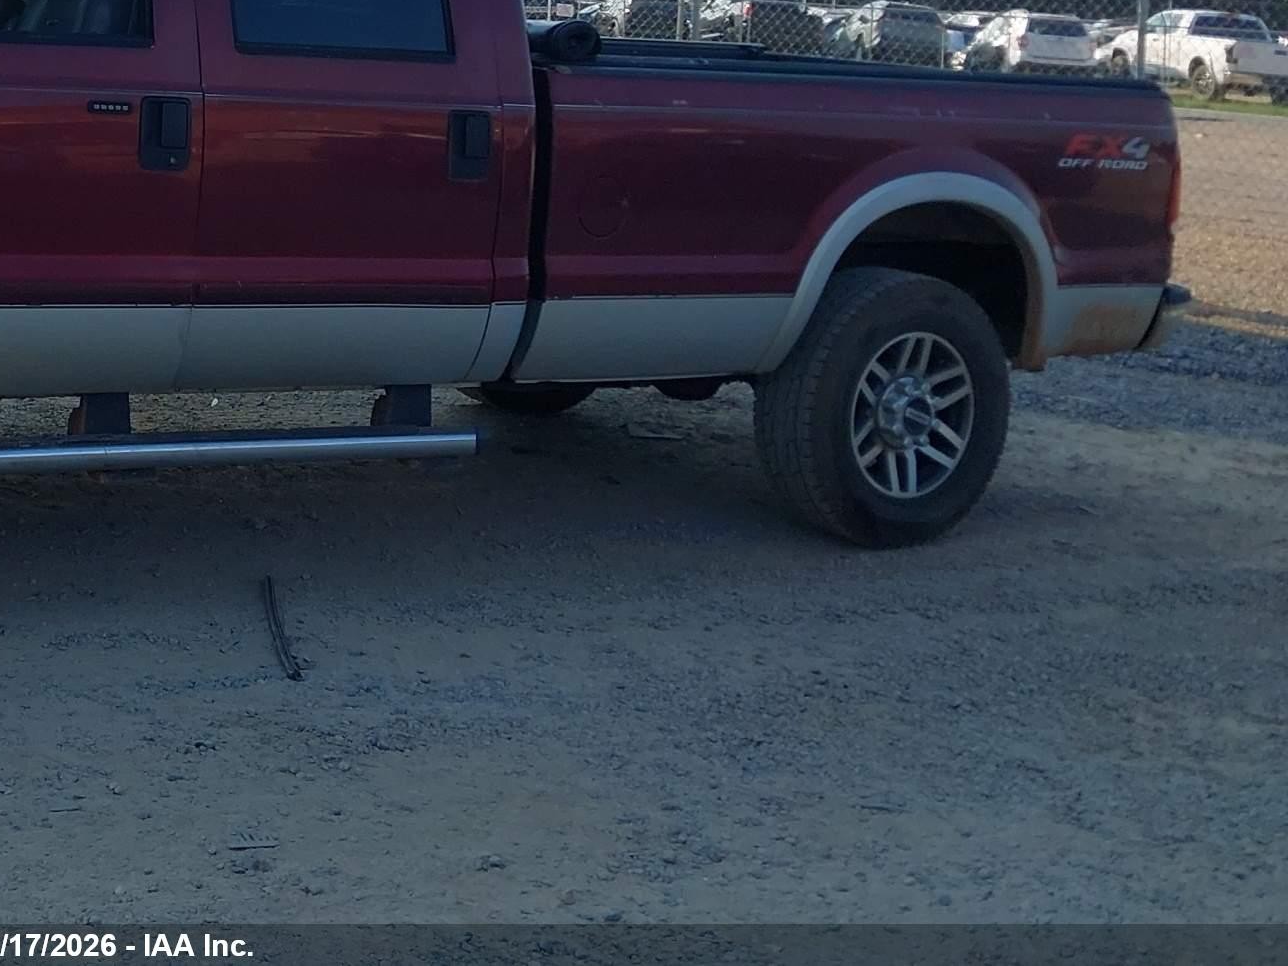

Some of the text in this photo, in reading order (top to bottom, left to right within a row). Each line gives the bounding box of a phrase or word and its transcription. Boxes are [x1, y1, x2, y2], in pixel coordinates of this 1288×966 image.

[1064, 136, 1151, 159] FX4
[1057, 157, 1148, 170] OFF ROAD
